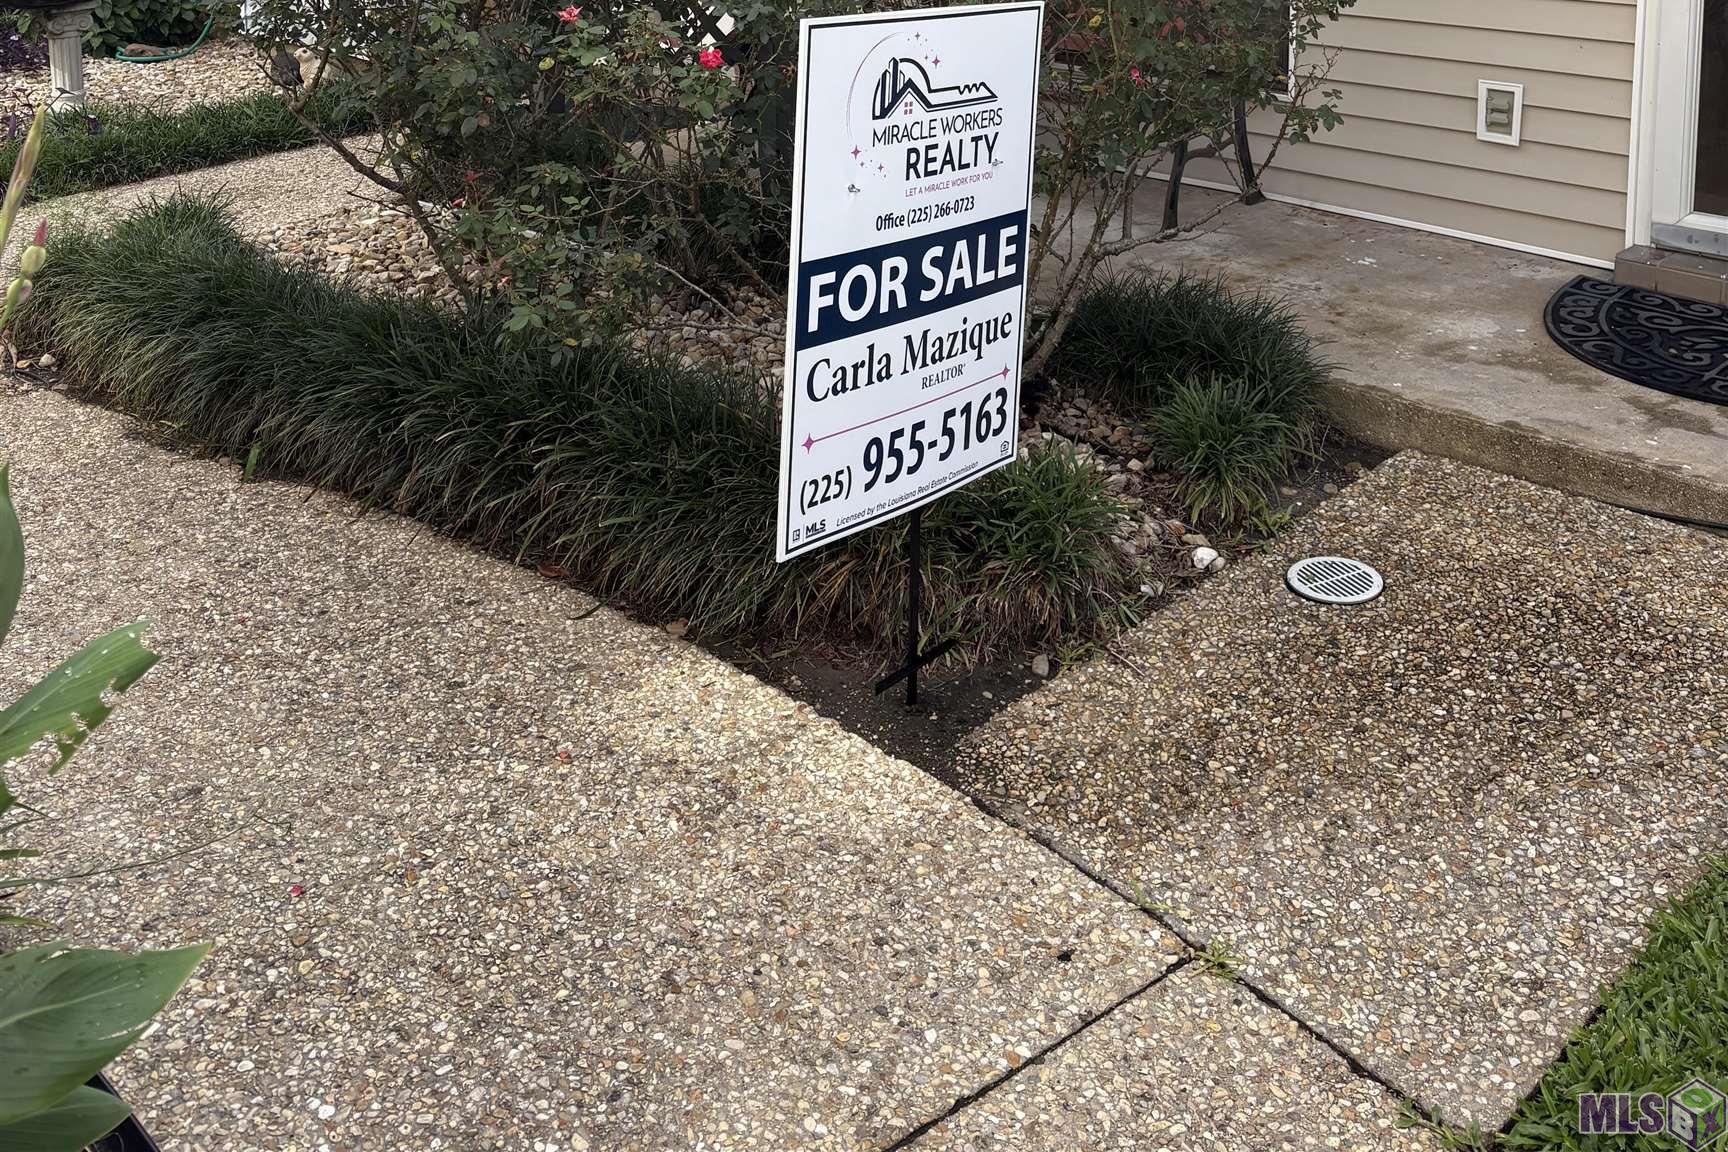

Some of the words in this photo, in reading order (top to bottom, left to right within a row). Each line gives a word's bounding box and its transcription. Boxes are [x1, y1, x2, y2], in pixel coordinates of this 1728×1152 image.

[872, 118, 938, 148] MIRACLE
[940, 108, 1003, 136] WORKERS
[905, 132, 1000, 182] REALTY
[905, 187, 919, 198] LET
[918, 185, 924, 195] A
[924, 180, 950, 194] MIRACLE
[951, 176, 968, 188] WORK
[968, 173, 981, 184] FOR
[981, 170, 993, 182] YOU
[876, 212, 905, 231] Office
[907, 205, 932, 228] (225)
[933, 195, 975, 219] 266-0723
[807, 255, 909, 333] FOR
[919, 225, 1018, 302] SALE
[806, 342, 893, 403] Carla
[900, 311, 1013, 375] Mazique
[800, 465, 852, 515] (225)
[863, 387, 1008, 493] 955-5163
[836, 509, 865, 527] Licensed
[867, 506, 875, 516] by
[876, 501, 887, 512] the
[887, 490, 917, 507] Louisiana
[917, 484, 930, 496] Real
[930, 476, 947, 489] Estate
[948, 461, 979, 481] Commission
[805, 519, 826, 535] MLS
